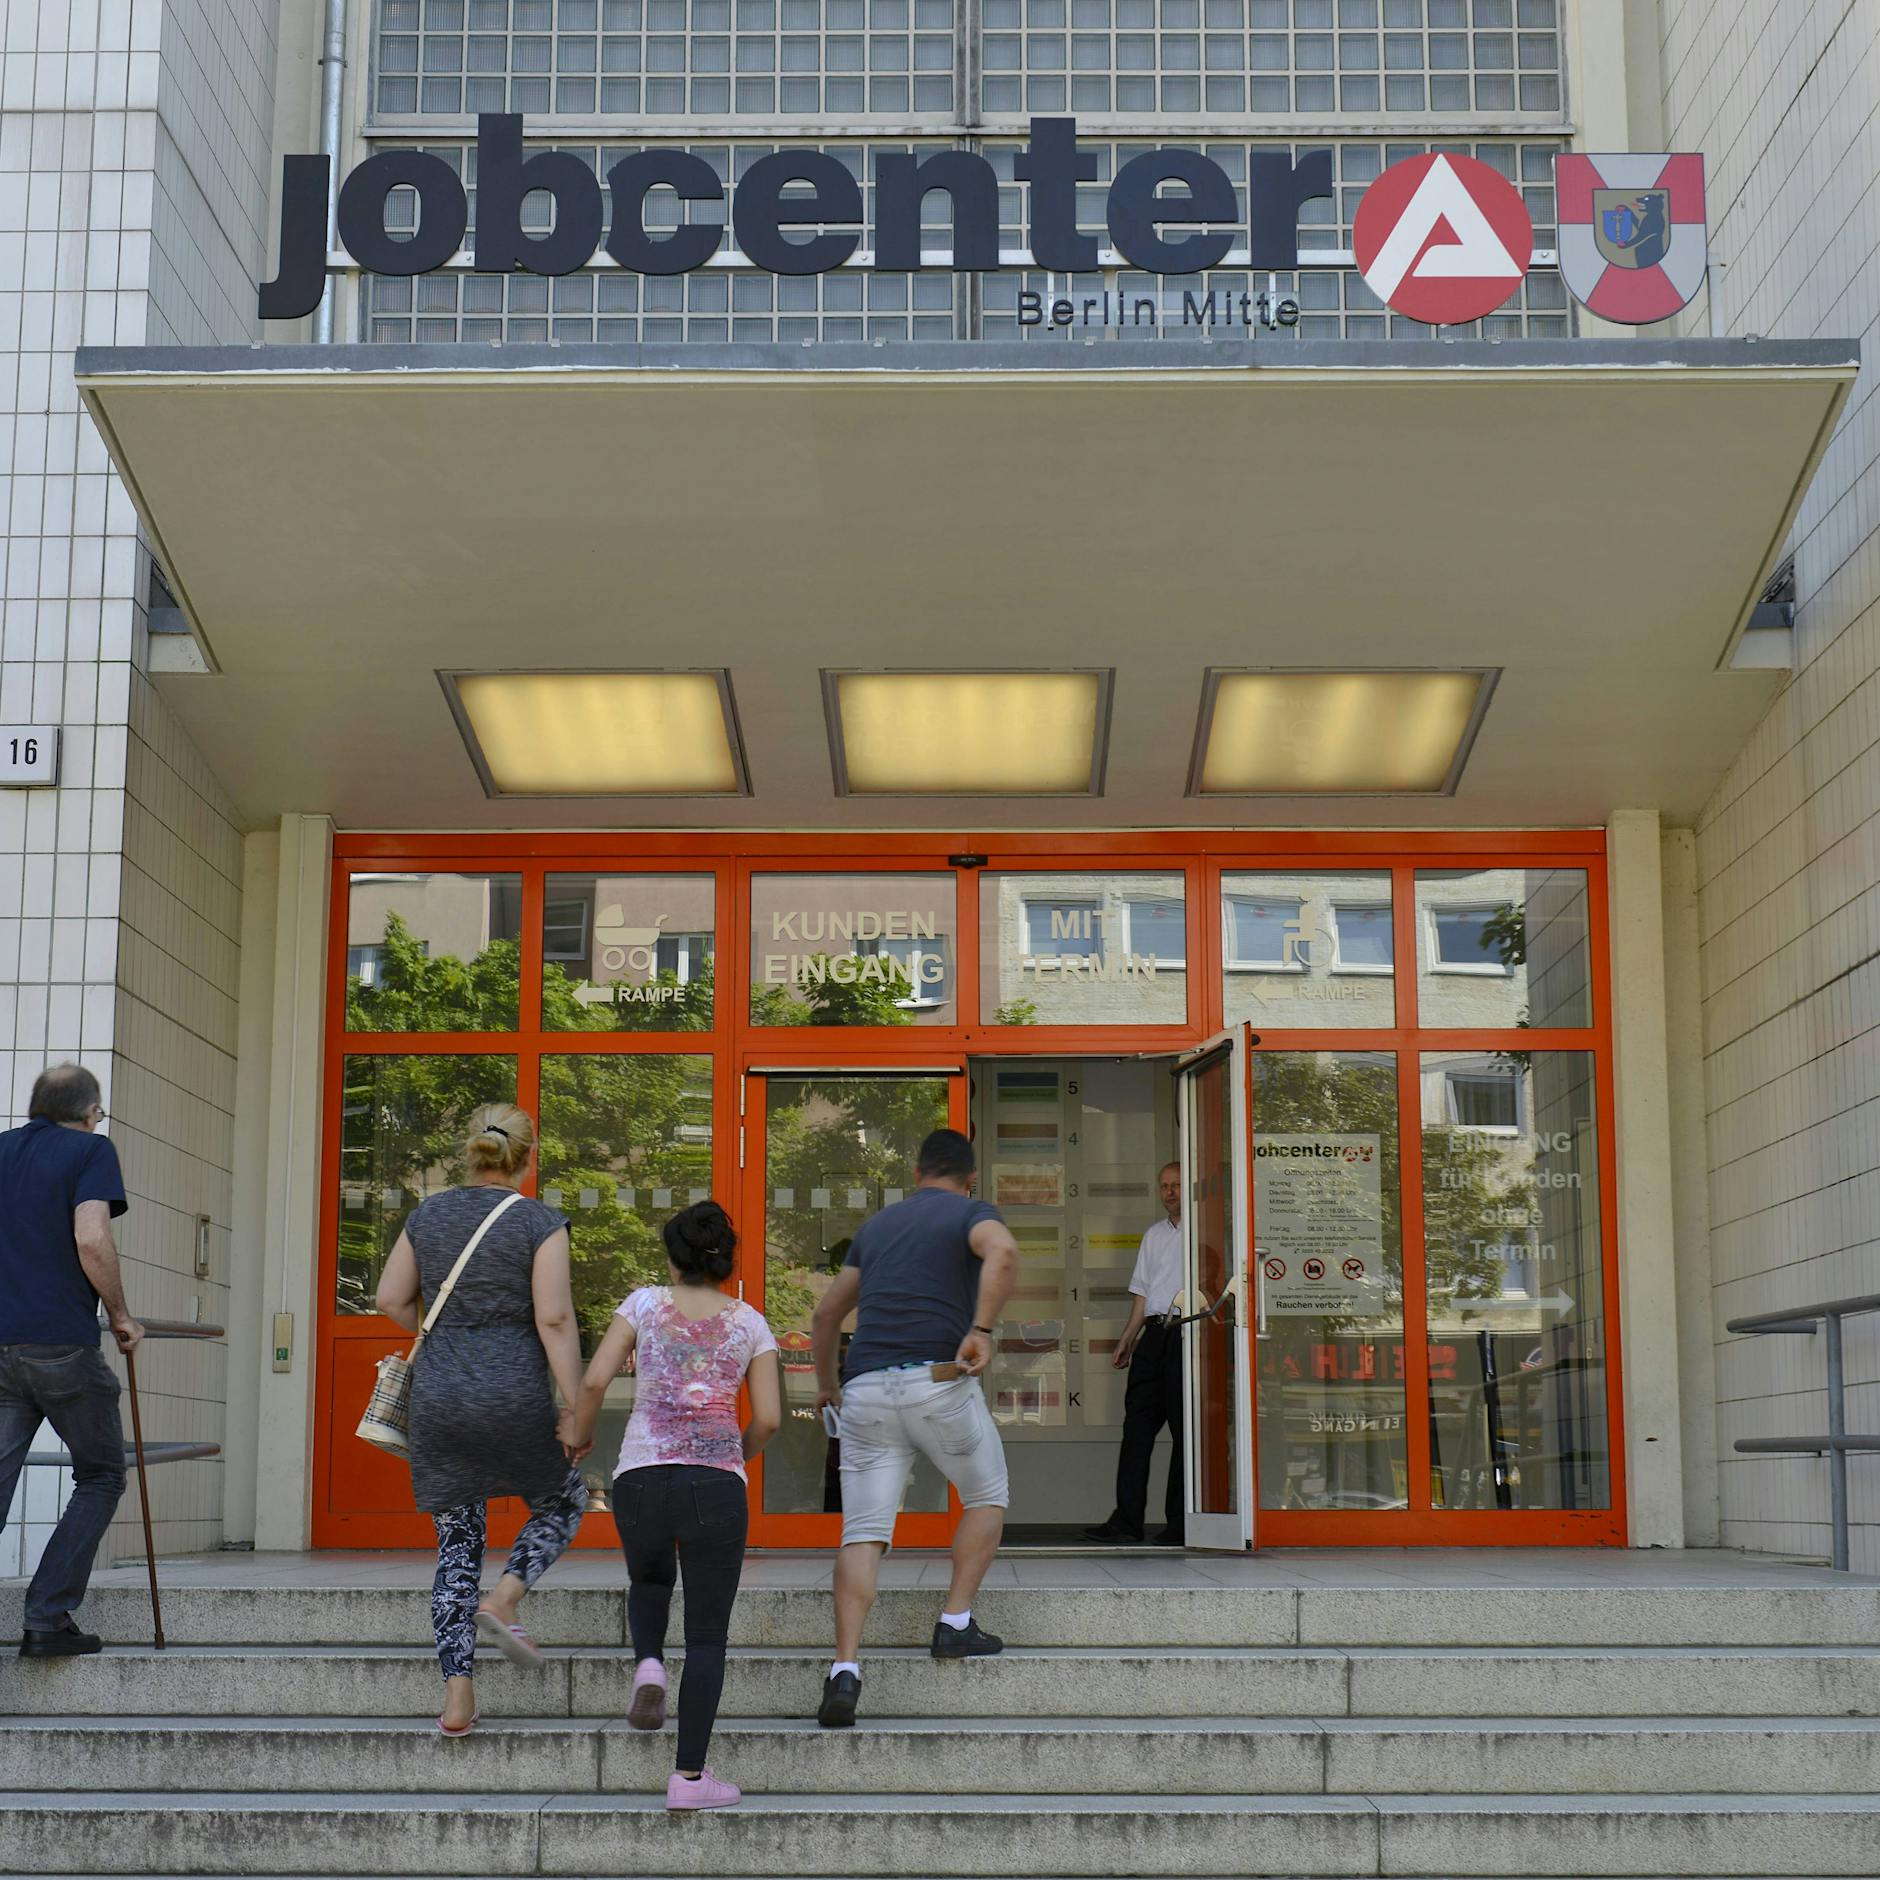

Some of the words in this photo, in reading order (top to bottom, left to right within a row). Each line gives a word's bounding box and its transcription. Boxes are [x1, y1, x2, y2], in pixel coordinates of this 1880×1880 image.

[258, 112, 1333, 319] jobcenter
[1017, 290, 1156, 326] Berlin
[1183, 289, 1301, 327] Mitte
[10, 738, 38, 765] 16
[771, 910, 936, 941] KUNDEN
[1051, 909, 1115, 940] MIT
[764, 953, 945, 986] EINGANG
[1014, 952, 1157, 984] TERMIN
[618, 986, 686, 1004] RAMPE
[1296, 984, 1366, 1001] RAMPE
[1067, 1081, 1079, 1095] 5
[1068, 1132, 1080, 1146] 4
[1449, 1131, 1572, 1153] EINNG
[1068, 1183, 1080, 1198] 3
[1068, 1235, 1080, 1249] 2
[1469, 1239, 1557, 1261] Termin
[1070, 1287, 1078, 1302] 1
[1276, 1301, 1313, 1309] Rauchen
[1068, 1339, 1080, 1354] E
[1068, 1392, 1081, 1407] K
